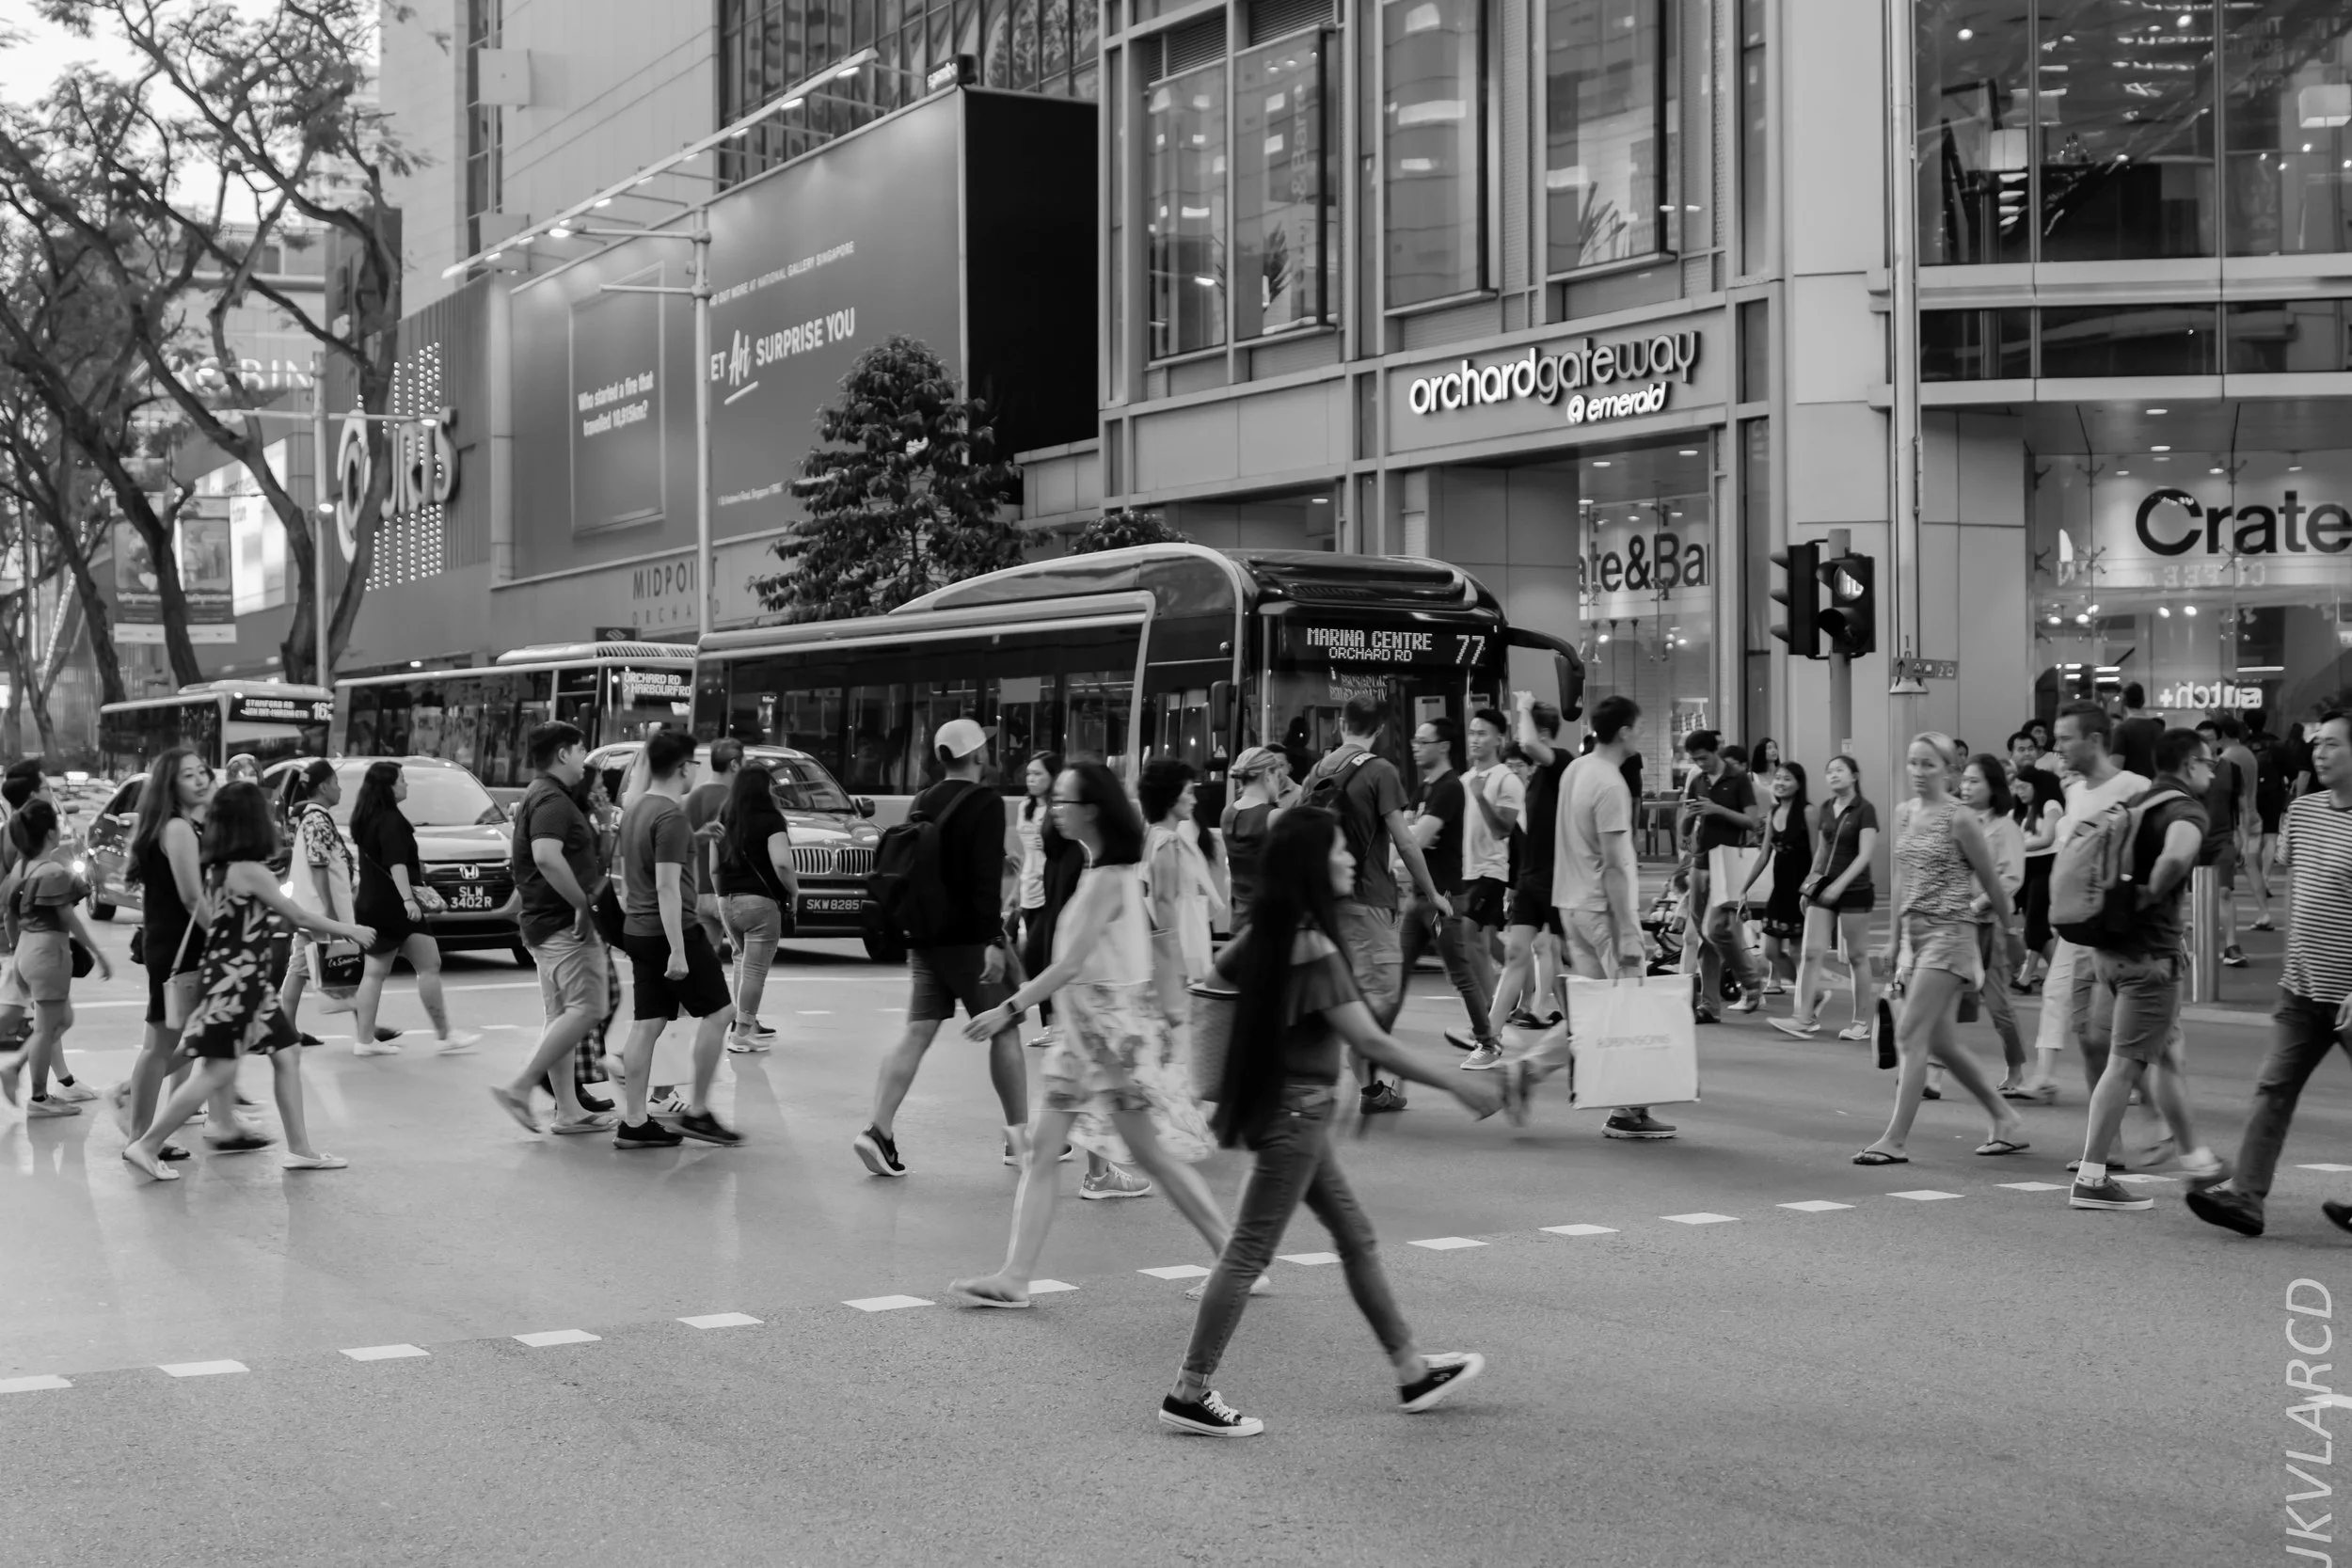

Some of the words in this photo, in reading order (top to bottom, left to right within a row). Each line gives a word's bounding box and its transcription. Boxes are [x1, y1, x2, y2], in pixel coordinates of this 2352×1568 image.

[787, 256, 815, 277] GALLERY
[816, 241, 854, 266] SINGAPORE
[710, 351, 726, 380] ET
[728, 329, 752, 386] Art
[755, 318, 824, 366] SURPRISE
[825, 307, 855, 342] YOU
[1409, 331, 1699, 415] orchardgateway
[578, 391, 594, 411] Who
[594, 381, 618, 406] started
[619, 383, 625, 399] a
[625, 376, 638, 396] fire
[638, 370, 654, 391] that
[1586, 380, 1668, 422] emerald
[583, 410, 612, 437] travelled
[2136, 488, 2352, 556] Crate
[632, 555, 718, 600] MIDPOIT
[632, 598, 721, 626] ORCHAD
[1307, 627, 1365, 647] MARINA
[1372, 631, 1433, 651] CENTRE
[1328, 647, 1391, 661] ORCHARD
[1394, 649, 1412, 662] RD
[1455, 634, 1486, 665] 77
[624, 672, 667, 685] ORCHARD
[668, 673, 682, 686] RD
[451, 895, 492, 909] 3402R
[458, 885, 485, 897] SLW
